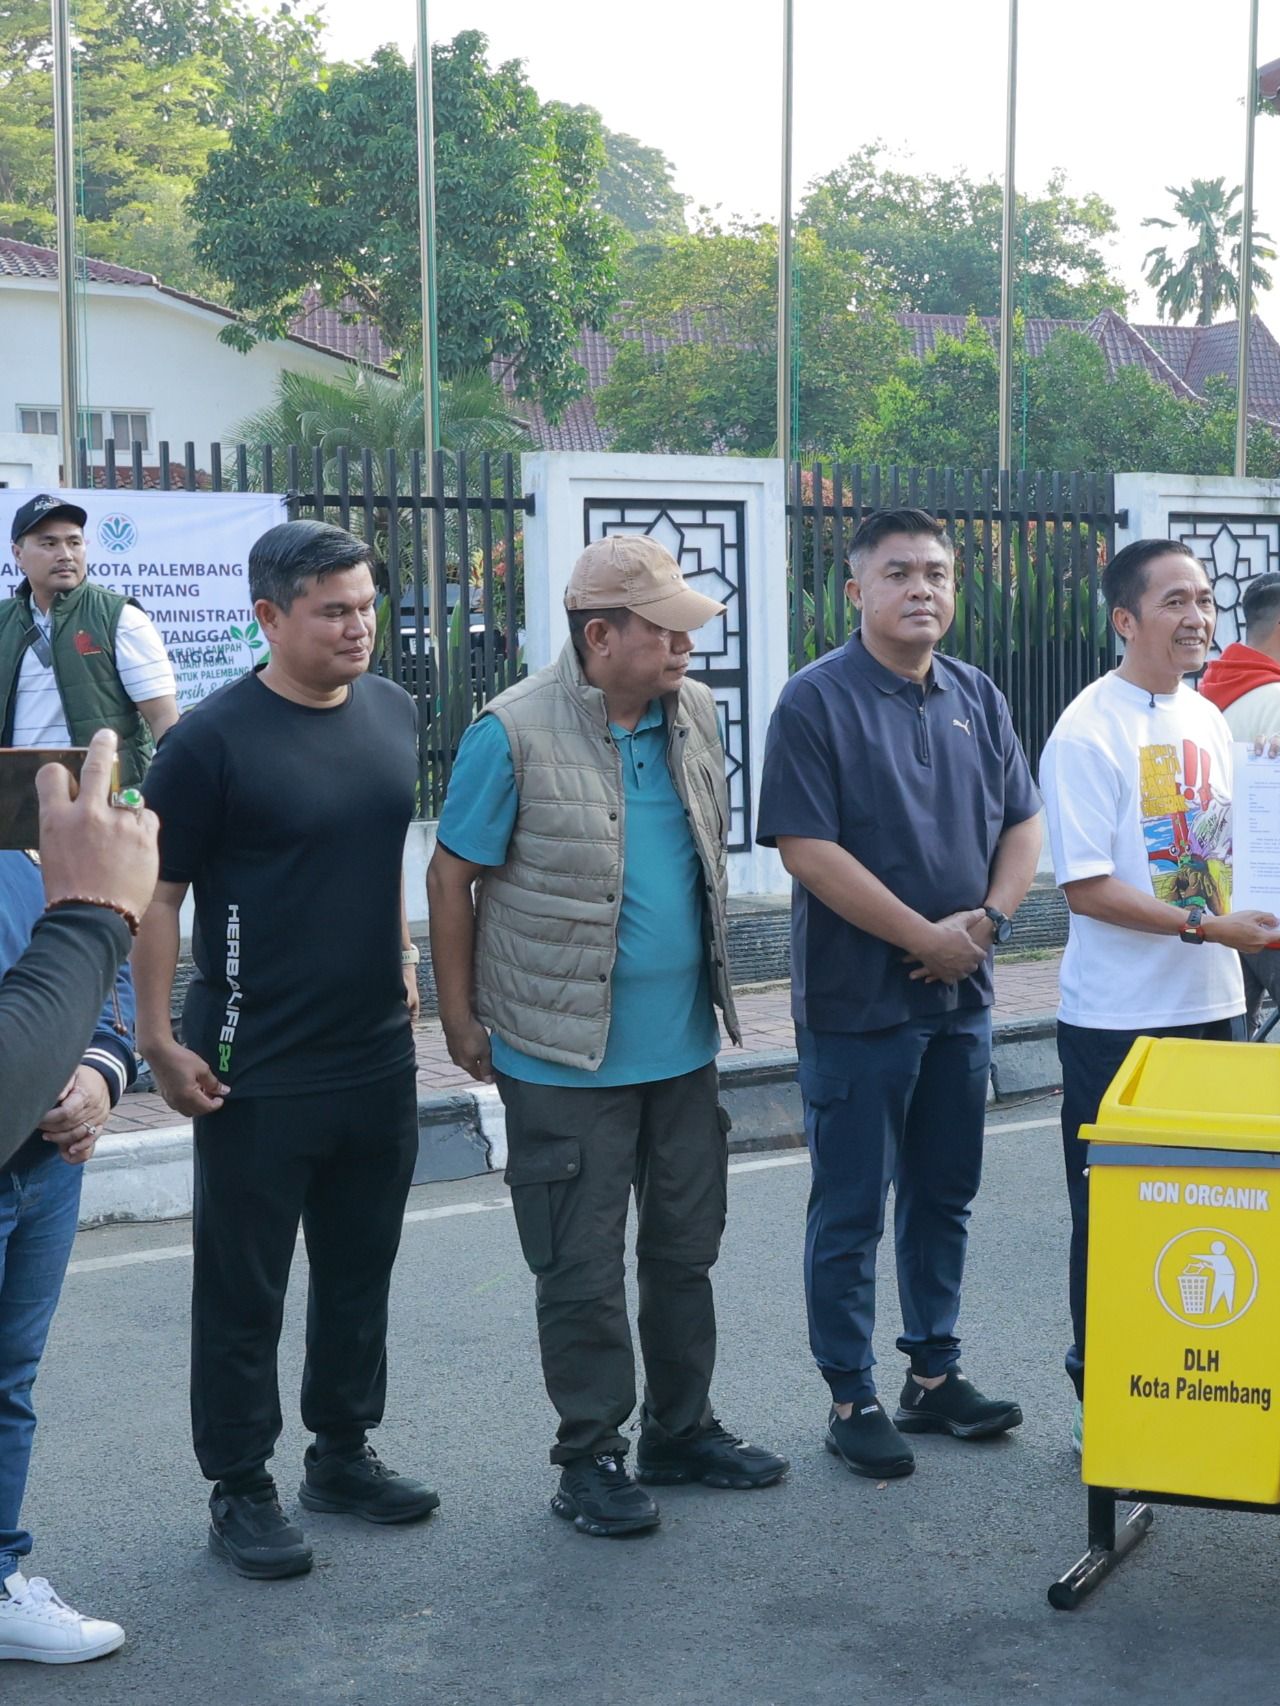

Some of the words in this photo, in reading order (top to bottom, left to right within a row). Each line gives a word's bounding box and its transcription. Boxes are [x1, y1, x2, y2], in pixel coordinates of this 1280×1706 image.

[87, 563, 132, 576] KOTA
[138, 563, 243, 576] PALEMBANG
[122, 584, 200, 597] TENTANG
[161, 630, 231, 644] TANGGA
[205, 643, 242, 654] SAMPAH
[174, 671, 198, 683] NTUK
[1139, 1181, 1180, 1203] NON
[1185, 1183, 1270, 1211] ORGANIK
[1184, 1348, 1219, 1372] DLH
[1130, 1374, 1169, 1399] Kota
[1176, 1377, 1271, 1411] Palembang
